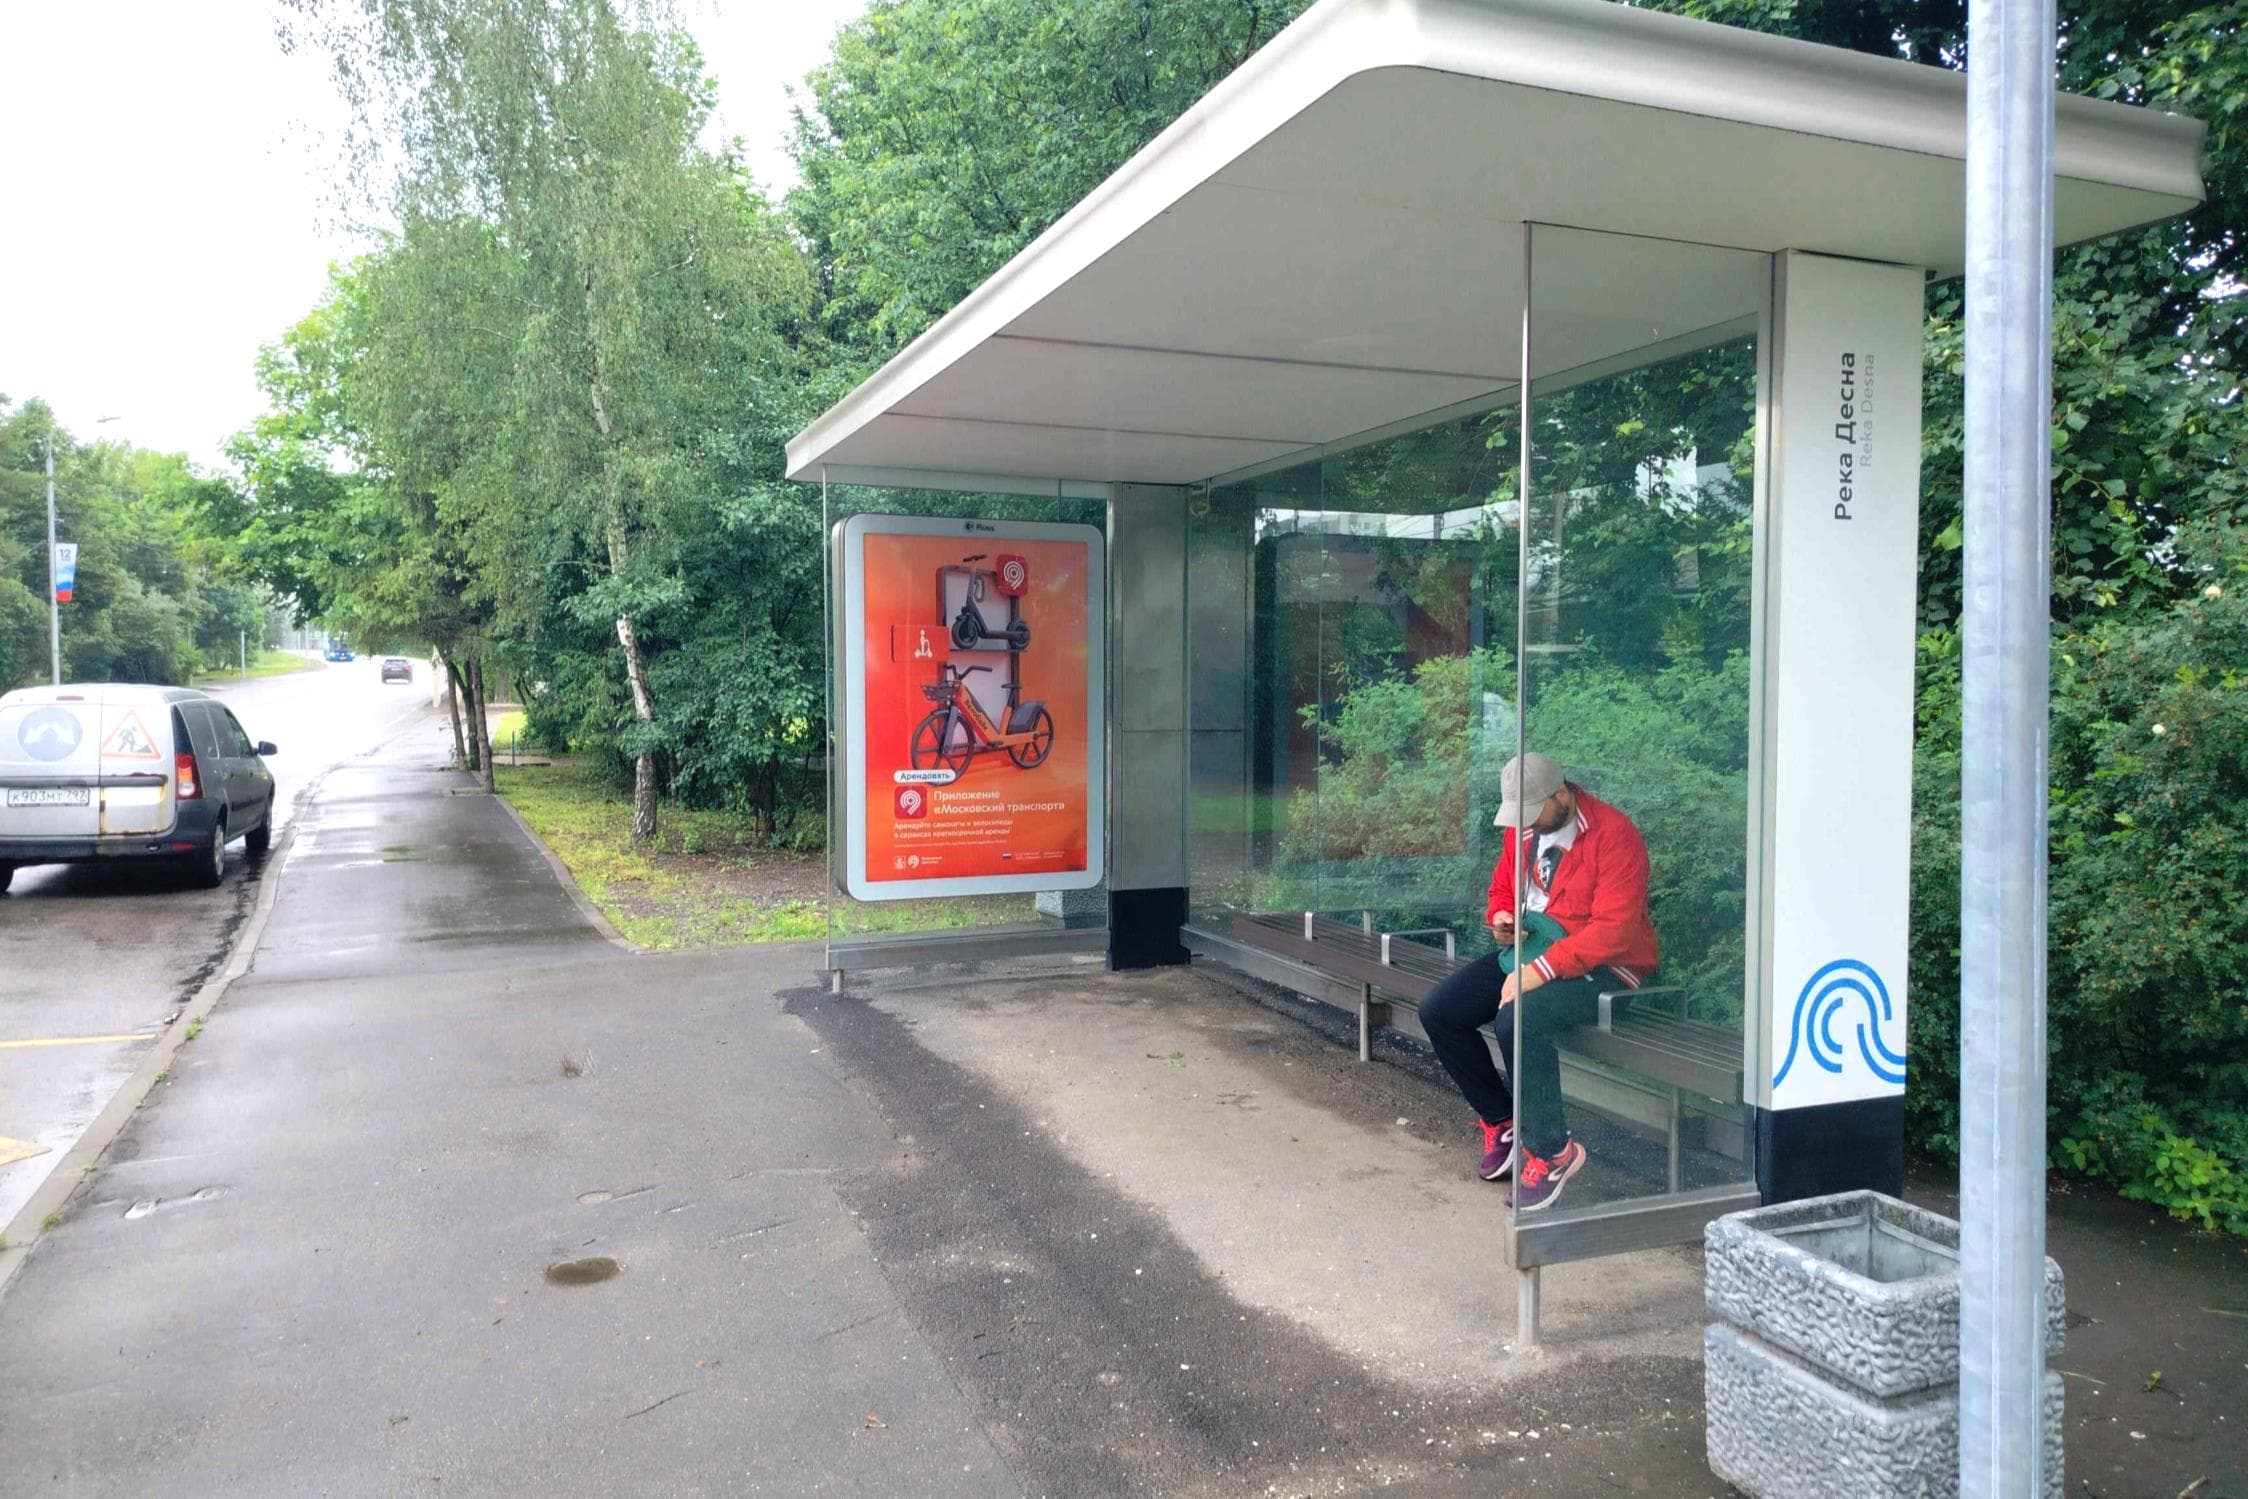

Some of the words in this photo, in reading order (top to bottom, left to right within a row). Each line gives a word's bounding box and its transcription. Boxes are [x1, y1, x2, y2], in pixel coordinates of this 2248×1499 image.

[1835, 352, 1857, 444] Десна
[1861, 354, 1875, 413] Desna
[1859, 419, 1873, 468] Reka
[1834, 453, 1853, 520] Река
[60, 549, 71, 561] 12
[900, 772, 951, 781] Арендовать
[934, 790, 1001, 802] Приложение
[934, 802, 1005, 815] «Московский
[1007, 801, 1065, 814] транспорт»
